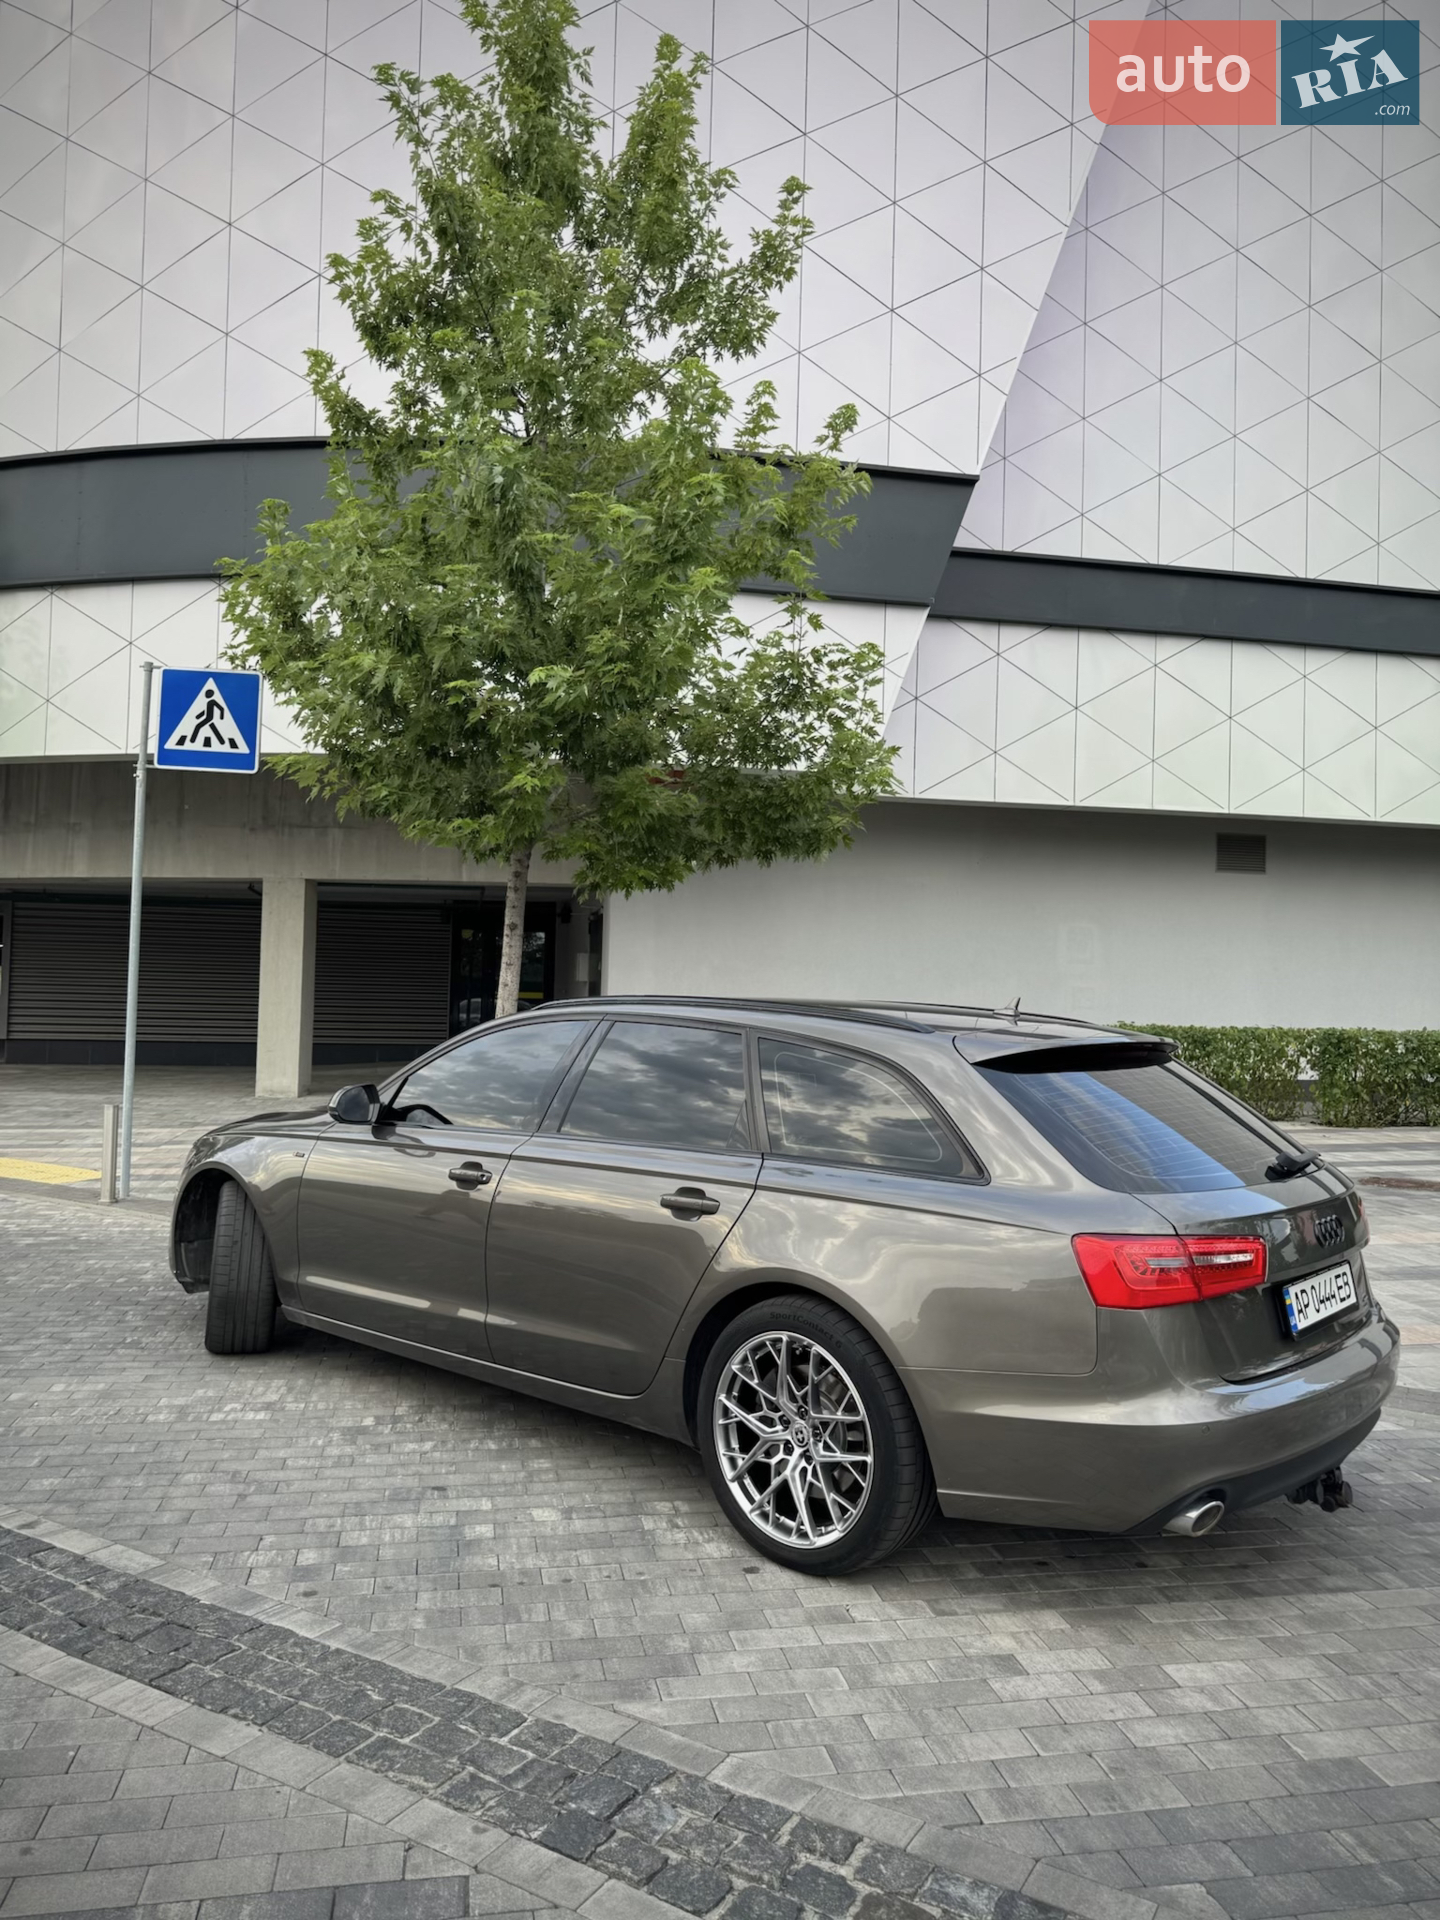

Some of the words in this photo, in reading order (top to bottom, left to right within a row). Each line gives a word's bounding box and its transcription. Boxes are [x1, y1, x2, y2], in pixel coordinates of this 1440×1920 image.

[1294, 1289, 1310, 1322] AP
[1311, 1277, 1338, 1314] 0444
[1334, 1271, 1352, 1302] EB
[769, 1311, 834, 1341] SportContact
